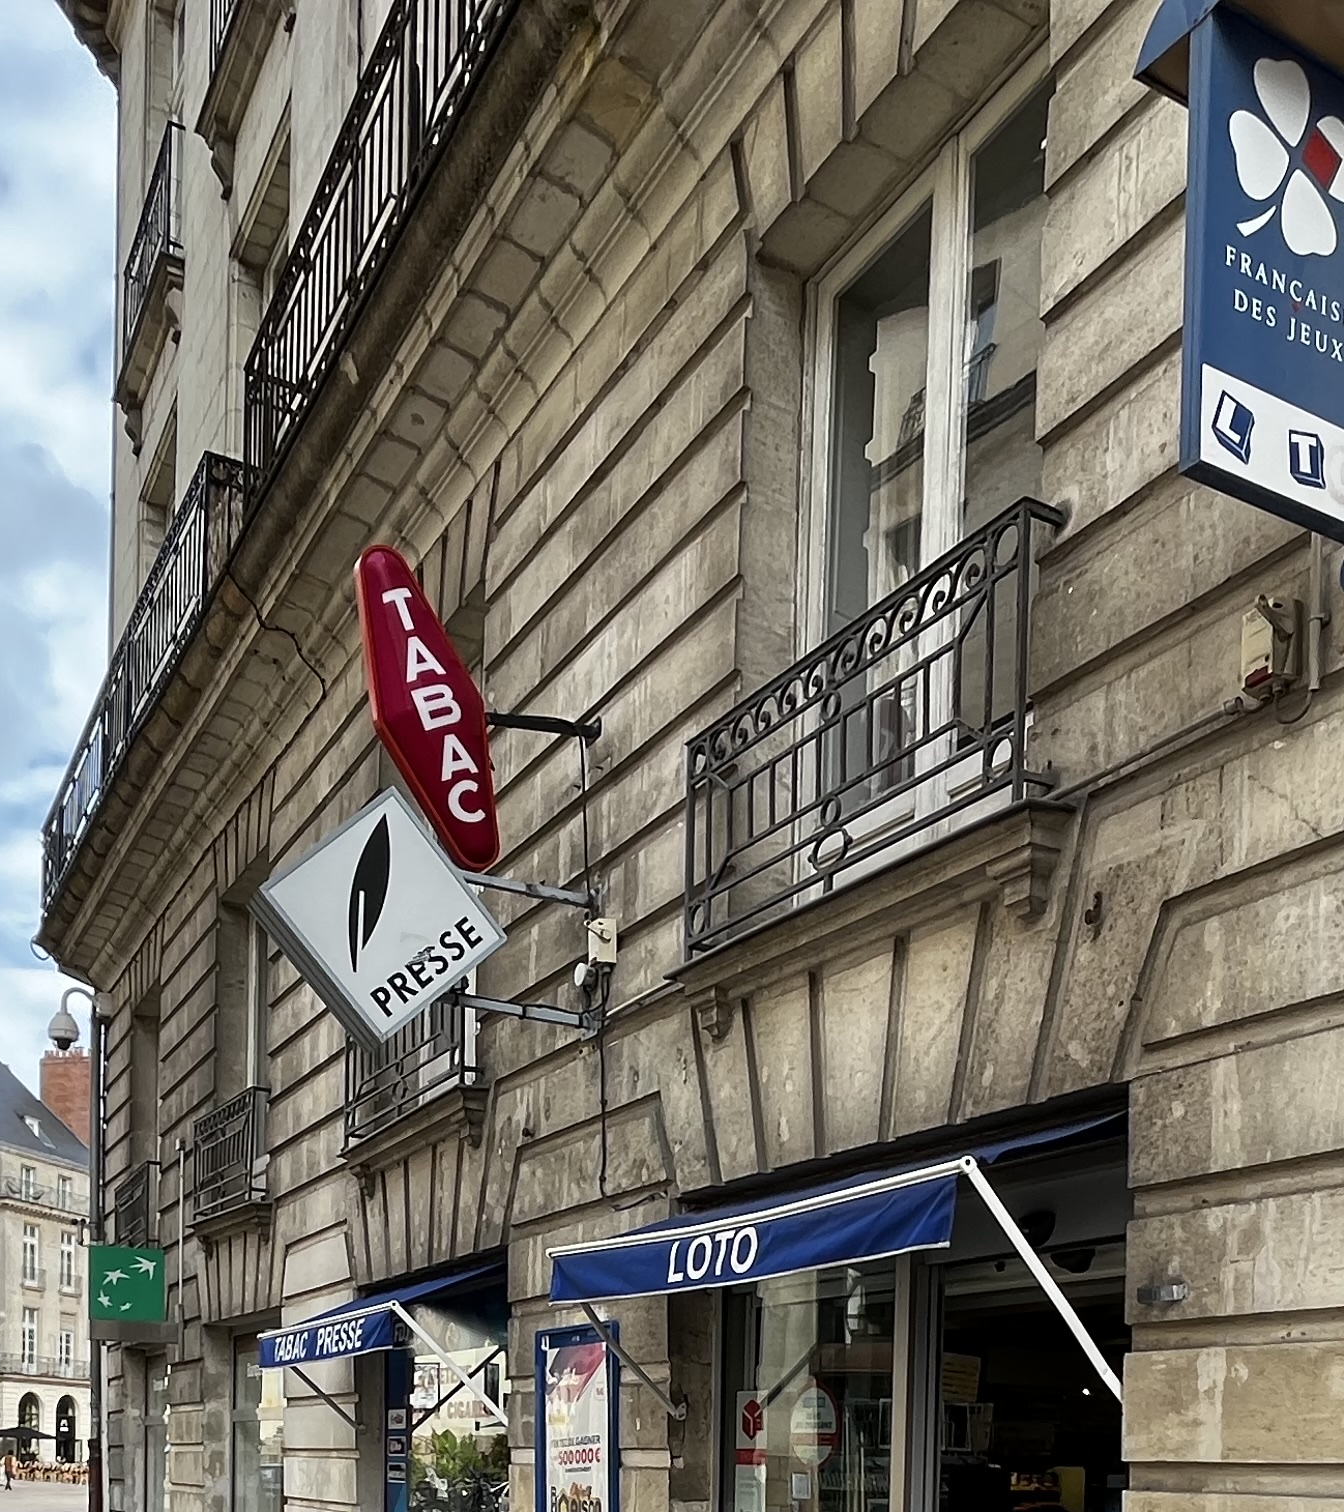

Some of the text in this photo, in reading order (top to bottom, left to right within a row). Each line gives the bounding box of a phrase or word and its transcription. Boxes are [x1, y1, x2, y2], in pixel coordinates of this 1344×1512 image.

[1234, 288, 1344, 362] DES JEUX
[381, 587, 487, 823] TABAC
[370, 916, 484, 1017] PRESSE
[666, 1226, 759, 1284] LOTO
[273, 1318, 366, 1363] TABAC PRESSE
